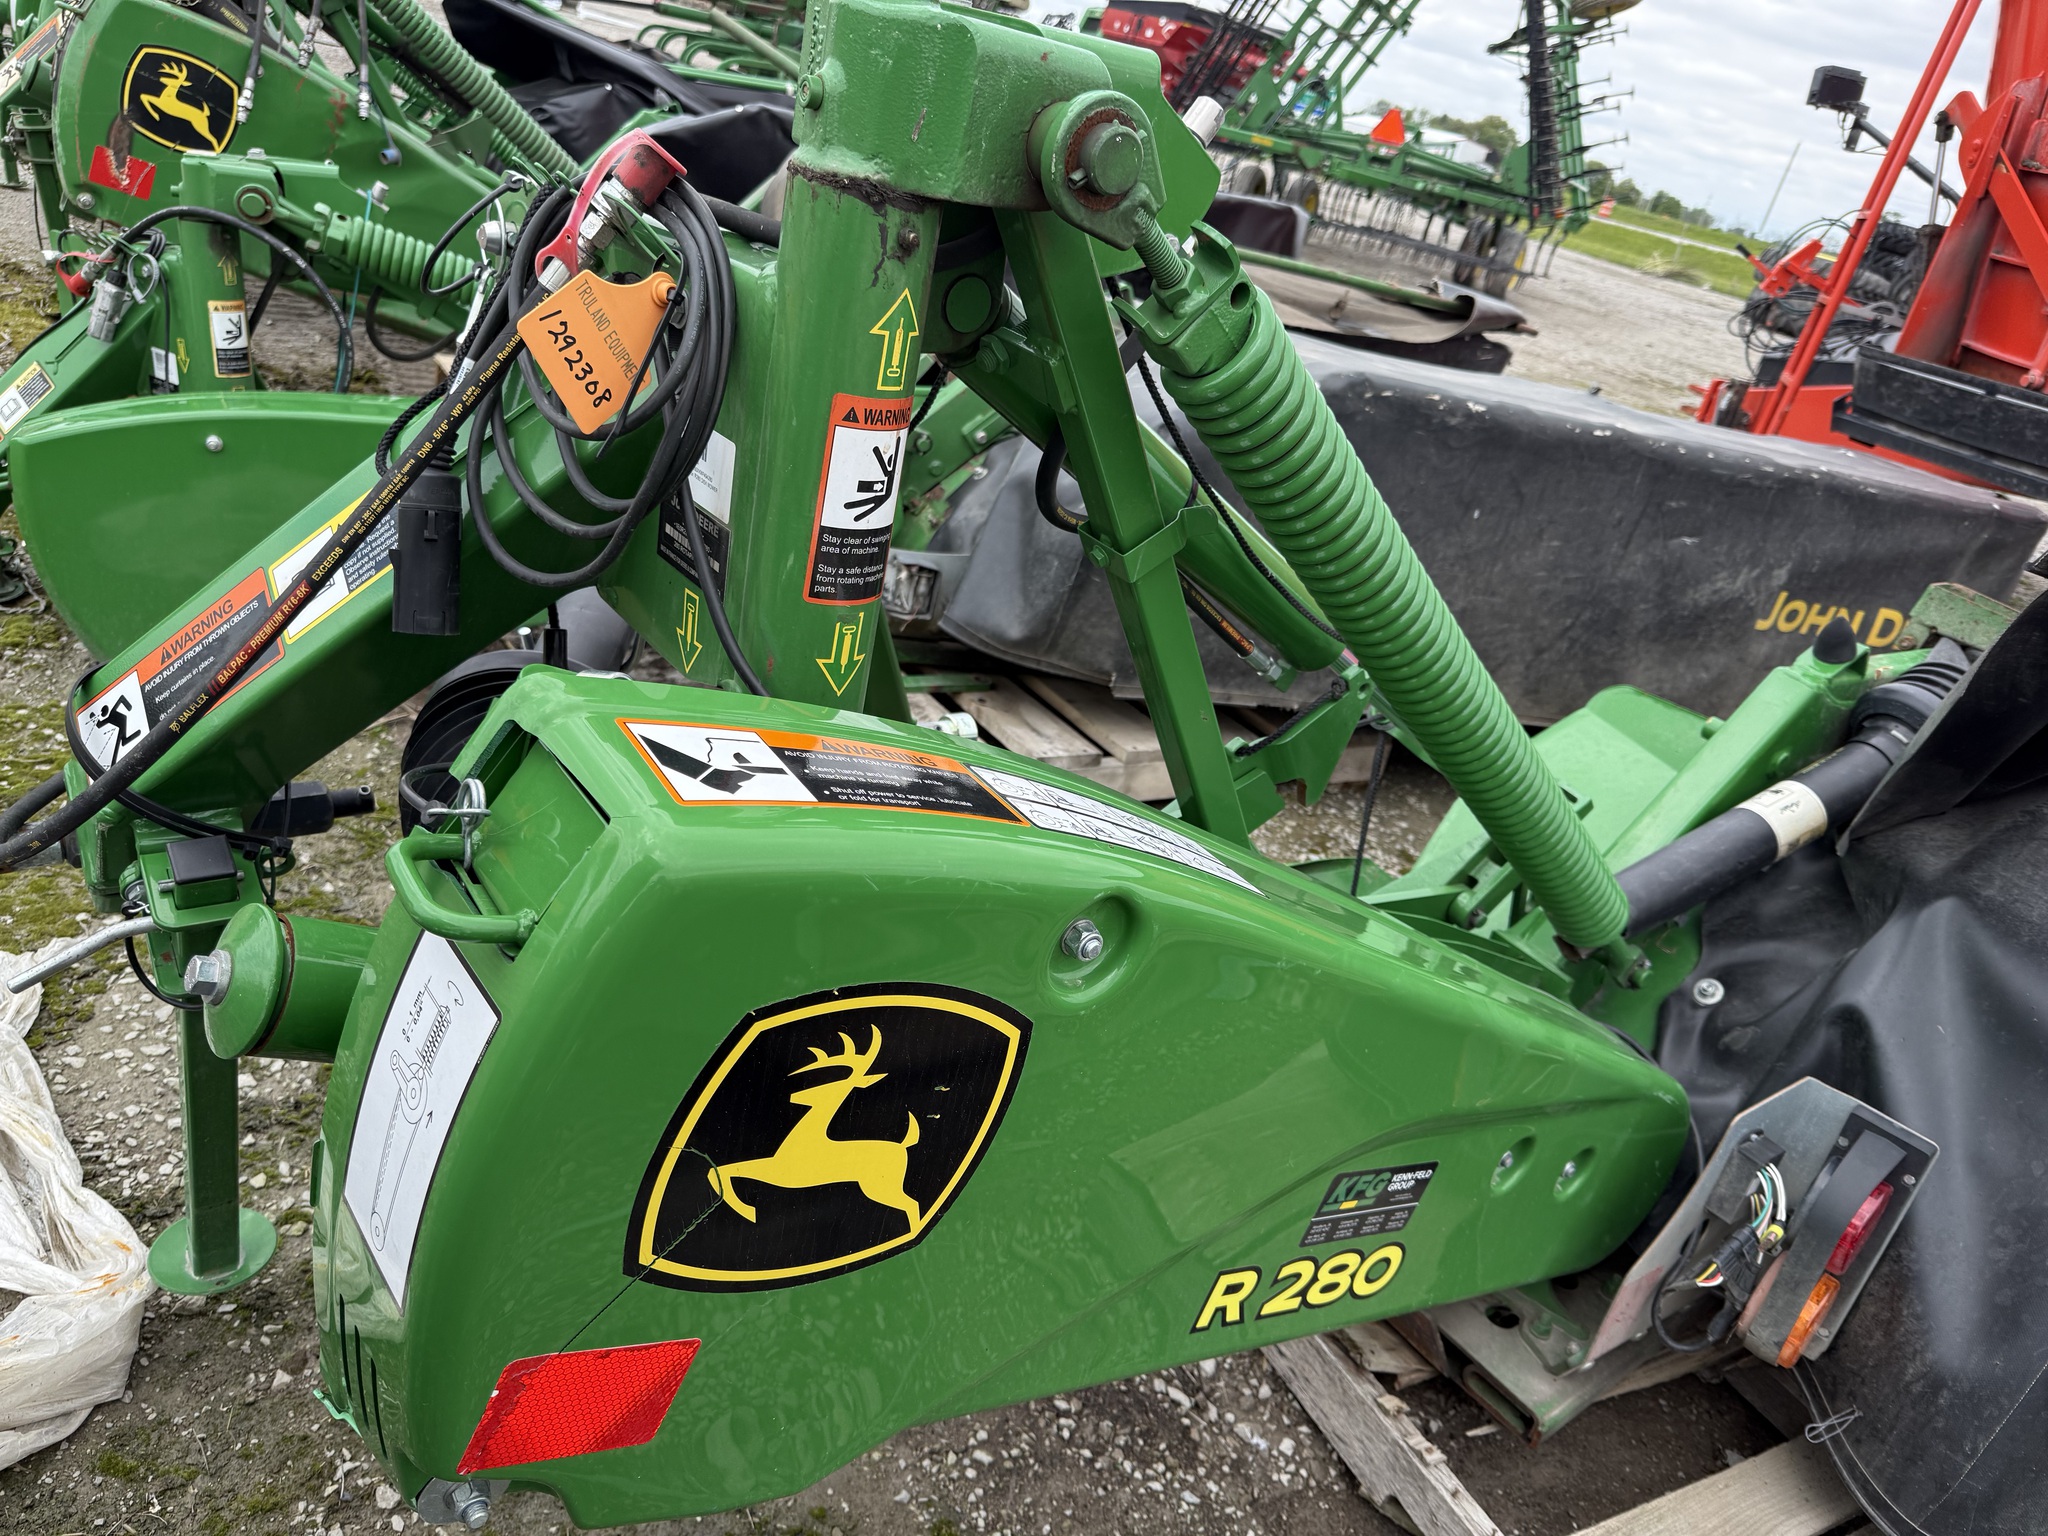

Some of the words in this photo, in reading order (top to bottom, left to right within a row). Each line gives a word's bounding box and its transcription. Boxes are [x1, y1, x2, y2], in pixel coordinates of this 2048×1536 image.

[576, 278, 610, 332] TRULAND
[417, 441, 433, 459] DN8
[451, 403, 465, 418] WP
[479, 361, 501, 382] Flame
[864, 408, 910, 426] WARNING
[697, 510, 719, 538] EERE
[366, 525, 390, 542] Request
[822, 534, 842, 544] Stay
[844, 535, 862, 545] clear
[864, 536, 871, 544] of
[344, 557, 358, 569] copy
[361, 545, 372, 556] not
[820, 545, 840, 553] area
[842, 545, 850, 554] of
[345, 556, 369, 575] Observe
[348, 572, 359, 583] and
[358, 560, 376, 578] safety
[818, 564, 837, 574] Stay
[845, 566, 861, 575] safe
[816, 574, 835, 584] from
[836, 575, 864, 585] rotating
[814, 584, 837, 594] parts.
[170, 599, 233, 655] WARNING
[178, 692, 209, 722] BALFLEX
[218, 651, 248, 684] BALPAC
[250, 612, 285, 650] PREMIUM
[312, 546, 344, 581] EXCEEDS
[144, 672, 163, 693] AVOID
[162, 657, 184, 679] INJURY
[184, 644, 203, 661] FROM
[202, 622, 230, 648] THROWN
[230, 600, 259, 626] OBJECTS
[155, 690, 170, 704] Keep
[170, 674, 193, 693] curtains
[192, 664, 199, 674] in
[198, 655, 215, 674] place.
[784, 750, 815, 759] AVOID
[816, 753, 851, 762] INJURY
[852, 758, 881, 766] FROM
[836, 743, 937, 767] WARNING
[810, 765, 835, 774] Keep
[836, 768, 864, 776] hands
[866, 770, 882, 778] and
[830, 786, 854, 794] Shut
[867, 778, 900, 787] running
[882, 798, 922, 806] transport
[1327, 1172, 1392, 1203] KFG
[1391, 1169, 1433, 1182] KENN-FELD
[1387, 1180, 1415, 1192] GROUP
[1189, 1266, 1262, 1334] R
[1255, 1242, 1406, 1320] 280
